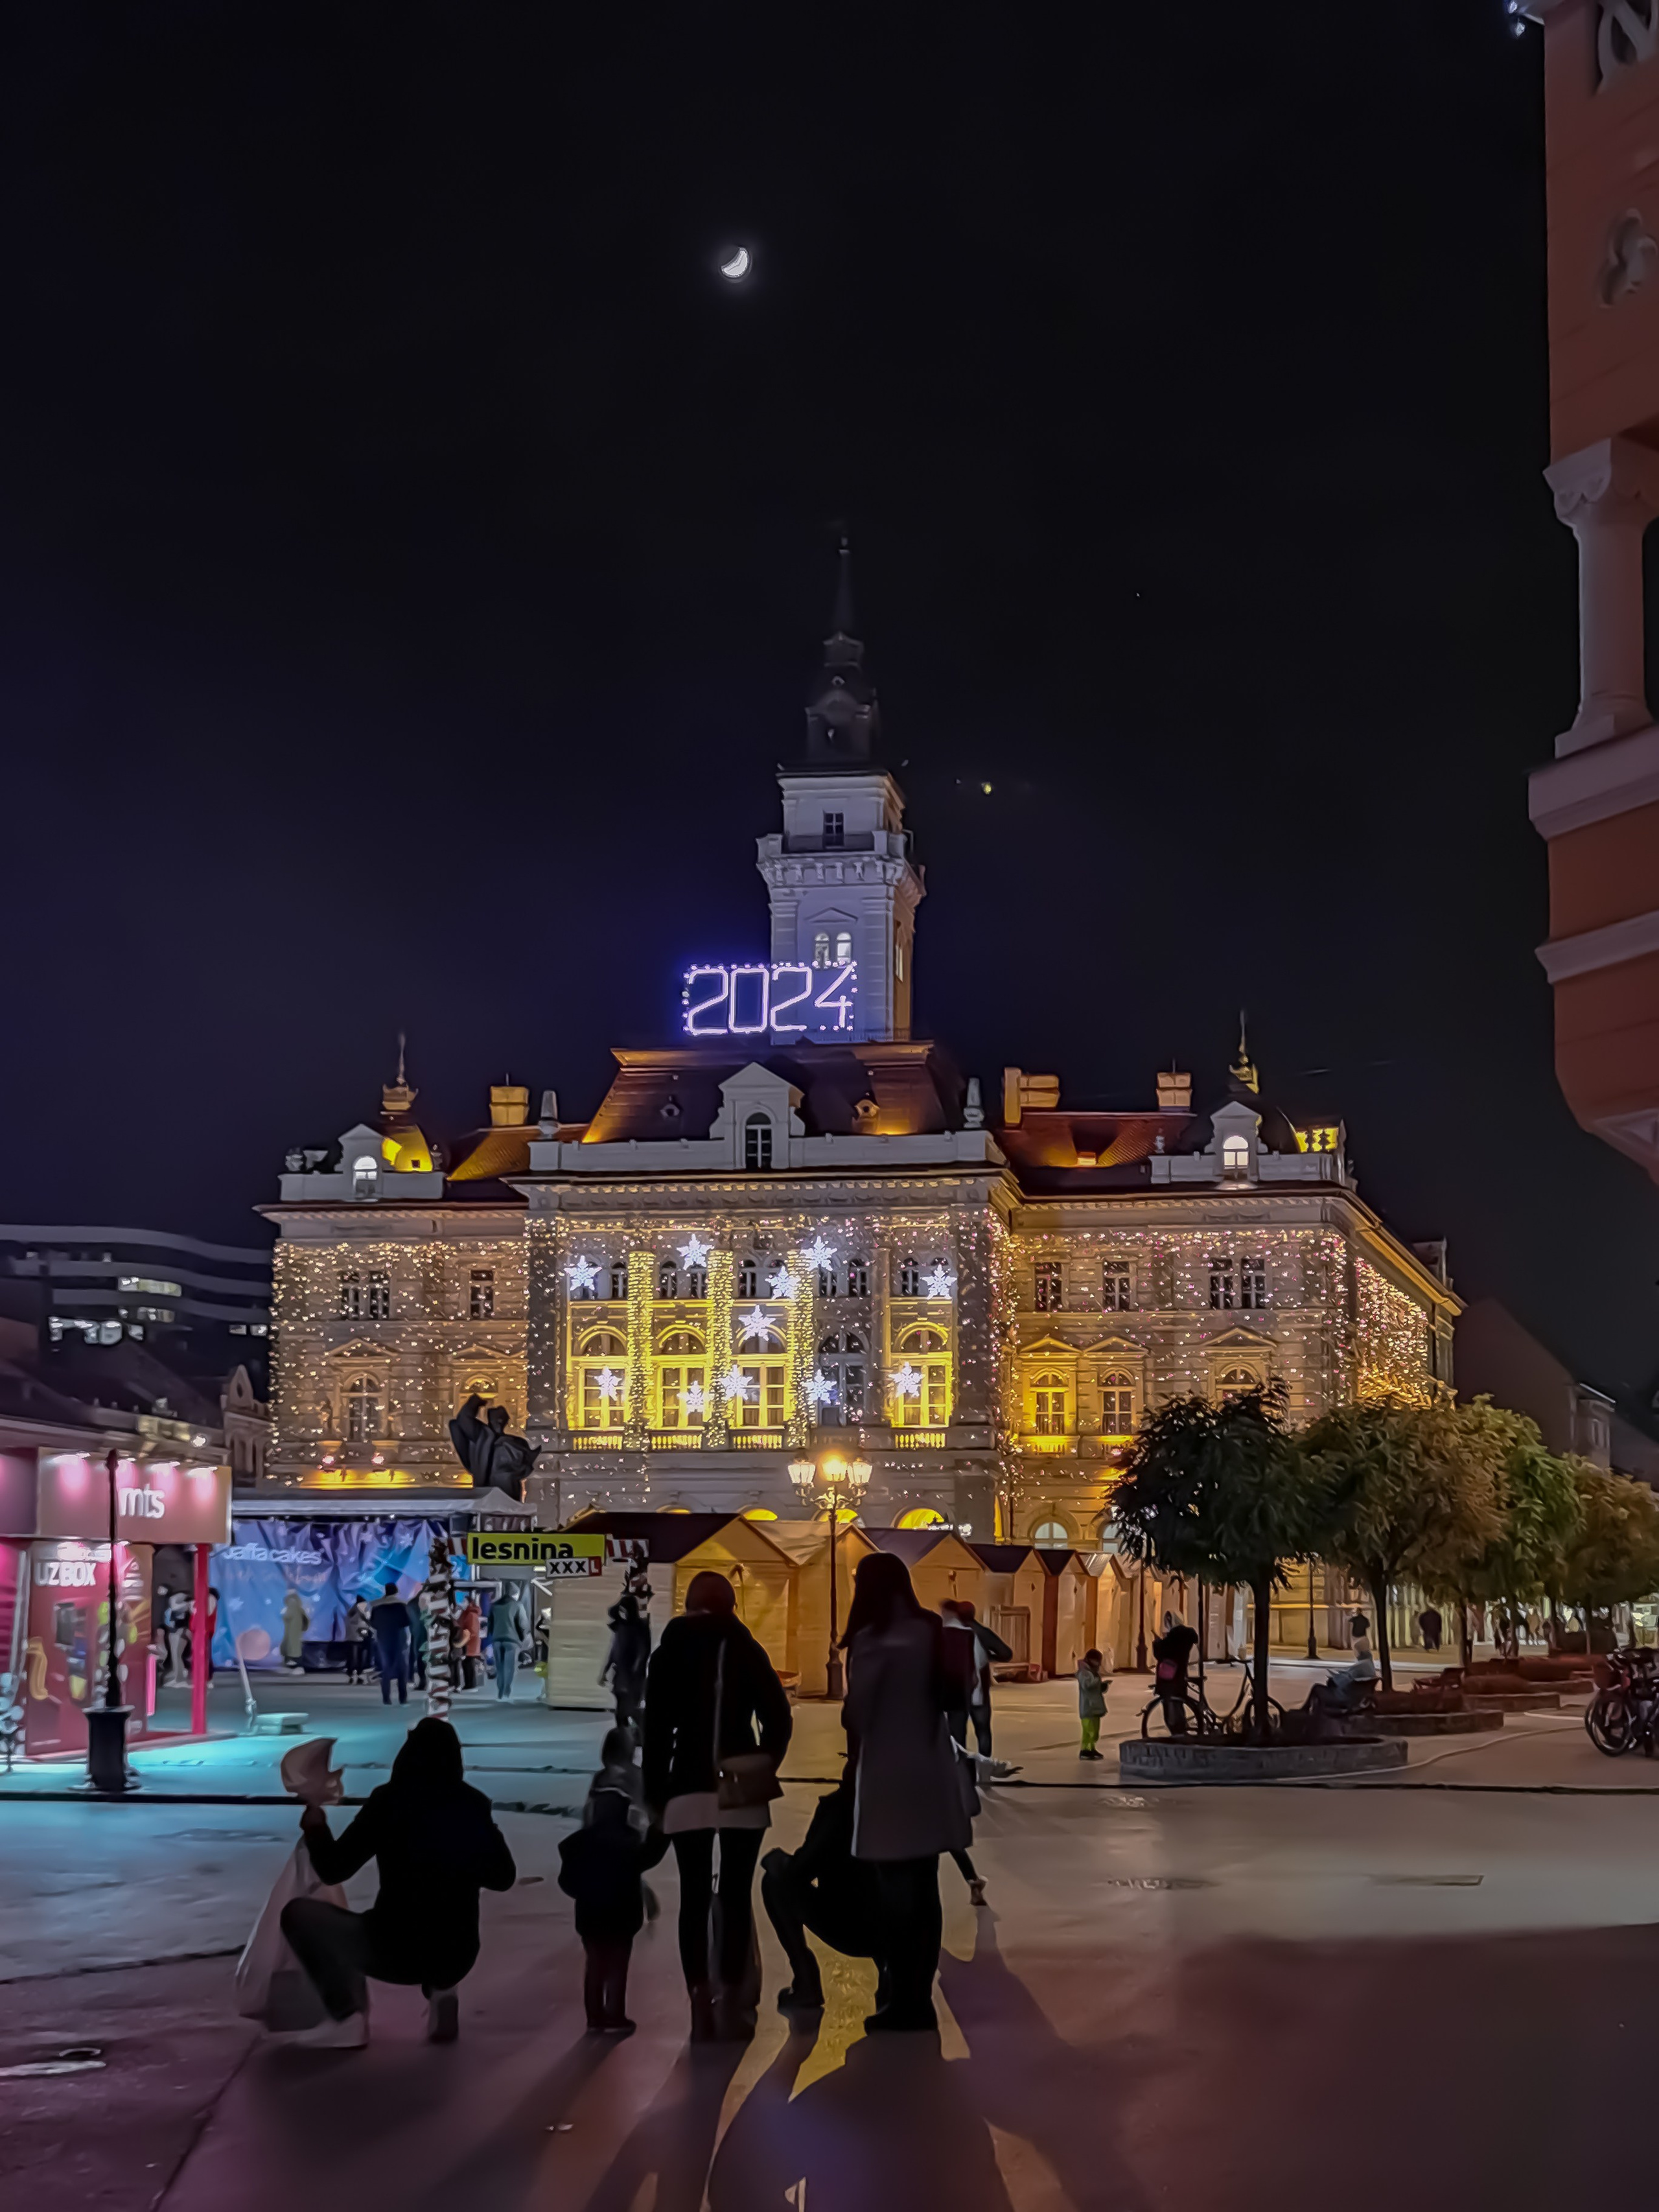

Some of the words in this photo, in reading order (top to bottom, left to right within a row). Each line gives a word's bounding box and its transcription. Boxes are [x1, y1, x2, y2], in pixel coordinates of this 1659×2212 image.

[687, 964, 853, 1035] 2024
[118, 1483, 165, 1519] mts
[472, 1537, 574, 1560] lesnina
